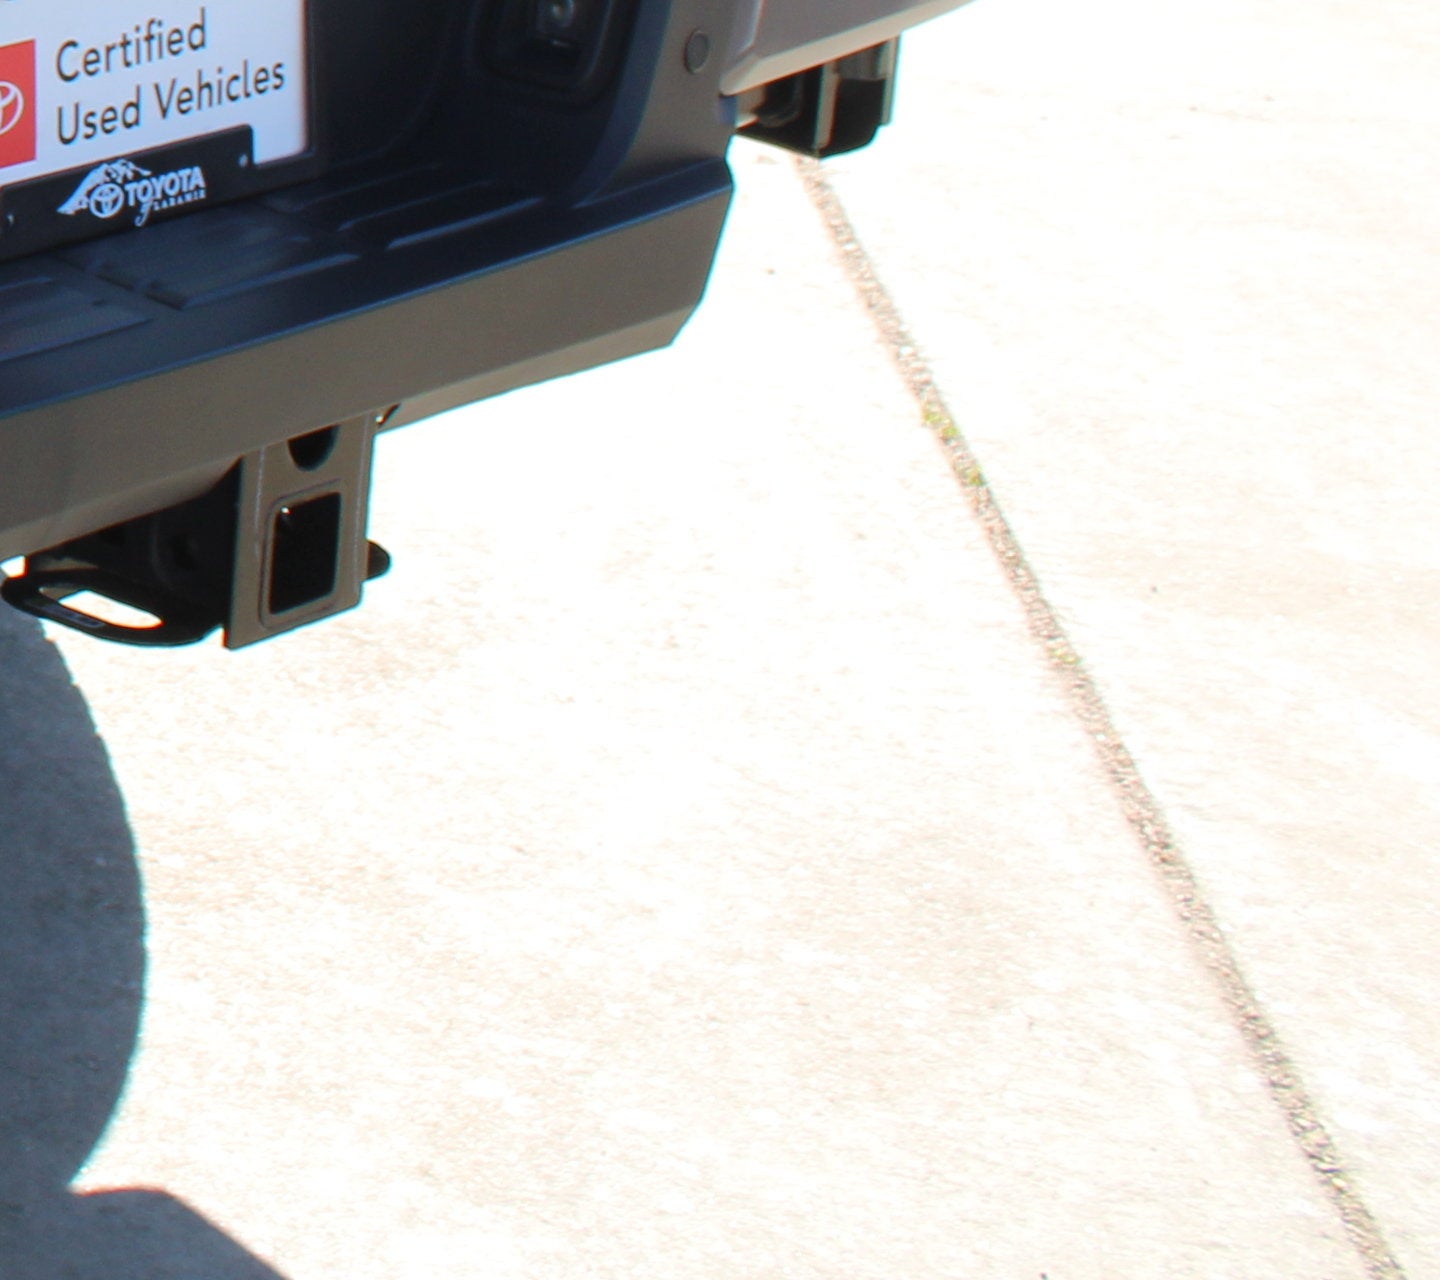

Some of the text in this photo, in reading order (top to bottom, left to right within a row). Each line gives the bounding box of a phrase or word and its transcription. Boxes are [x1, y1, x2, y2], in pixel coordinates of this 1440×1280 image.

[56, 7, 207, 83] Certified
[57, 59, 285, 145] Used Vehicles
[124, 165, 206, 207] TOYOTA
